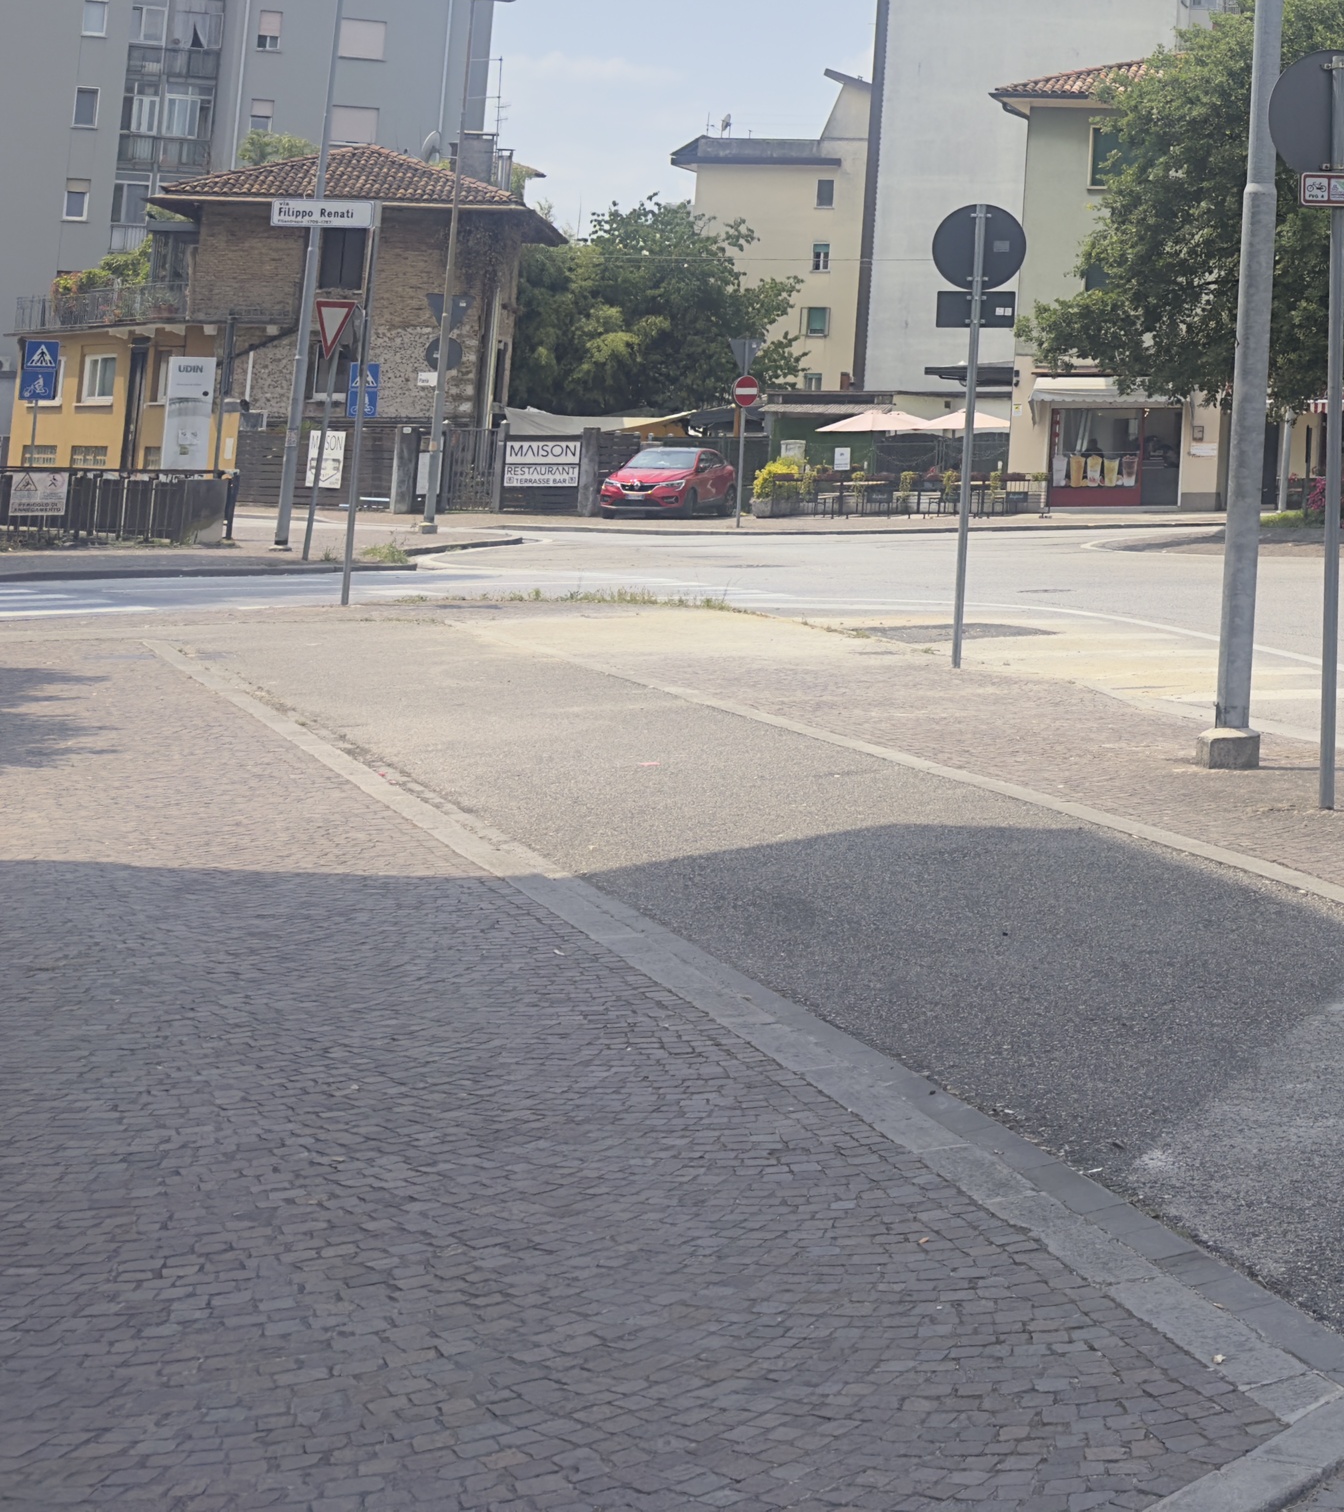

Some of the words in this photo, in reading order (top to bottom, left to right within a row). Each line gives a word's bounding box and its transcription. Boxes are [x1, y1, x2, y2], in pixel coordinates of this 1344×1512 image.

[278, 207, 313, 219] Filippo
[320, 208, 354, 219] Renati
[311, 434, 343, 451] MSON
[509, 444, 577, 458] MAISON
[506, 466, 577, 476] RESTAURANT
[515, 477, 551, 485] TERRASSE
[552, 477, 567, 485] BAR
